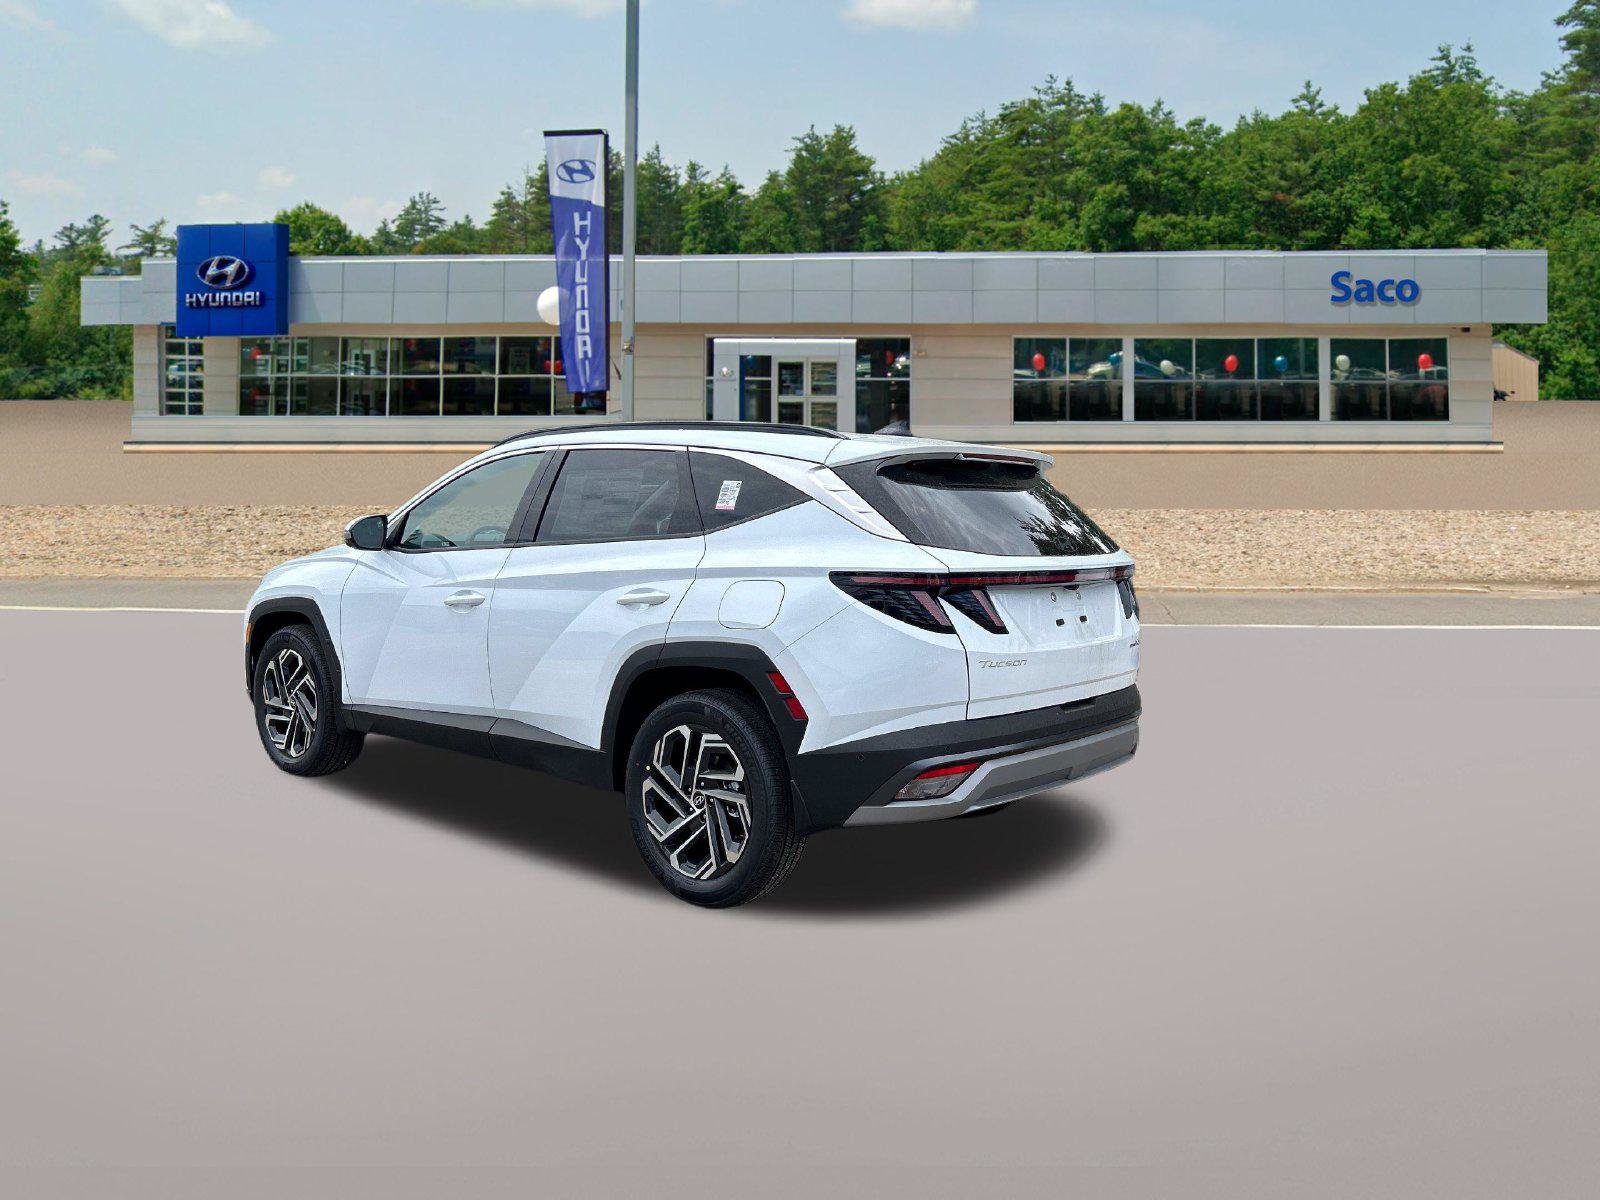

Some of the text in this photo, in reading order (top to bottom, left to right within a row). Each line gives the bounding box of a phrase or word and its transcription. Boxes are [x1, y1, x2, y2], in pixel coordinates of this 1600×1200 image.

[185, 291, 260, 307] HYUNDAI
[573, 211, 592, 383] HYUNDAI
[1331, 270, 1420, 302] Saco
